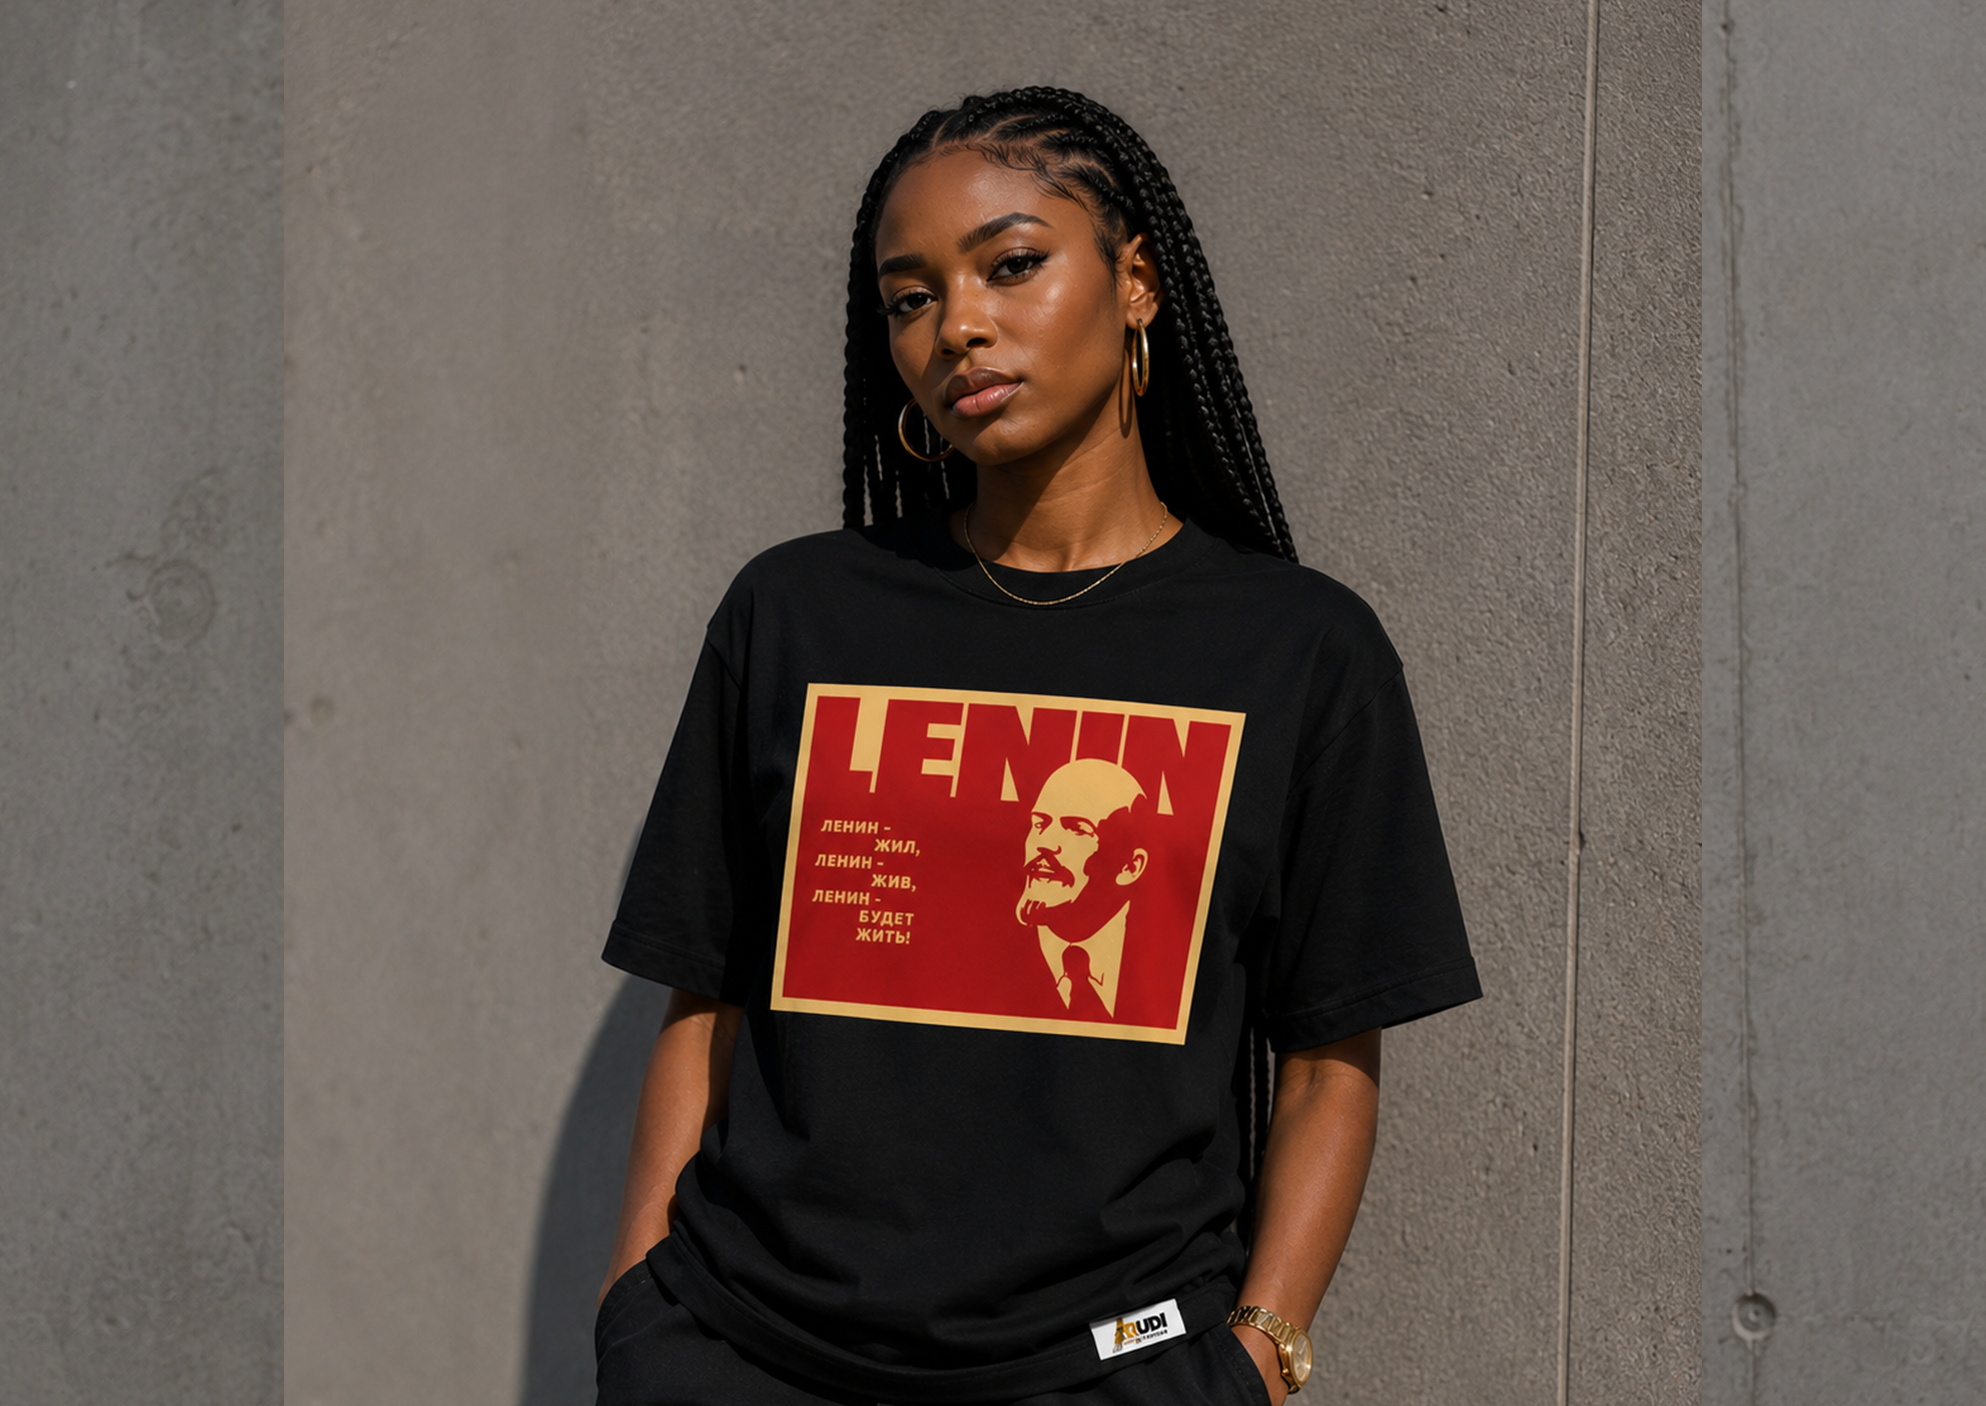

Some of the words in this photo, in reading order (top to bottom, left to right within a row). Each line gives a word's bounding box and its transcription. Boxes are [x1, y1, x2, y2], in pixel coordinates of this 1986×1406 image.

[807, 696, 1232, 816] LENIN
[821, 820, 878, 834] ЛЕНИН
[874, 839, 920, 856] ЖИЛ,
[815, 854, 872, 869] ЛЕНИН
[871, 874, 916, 892] ЖИВ,
[812, 890, 870, 905] ЛЕНИН
[859, 910, 914, 927] БУДЕТ
[856, 928, 910, 944] ЖИТЬ!
